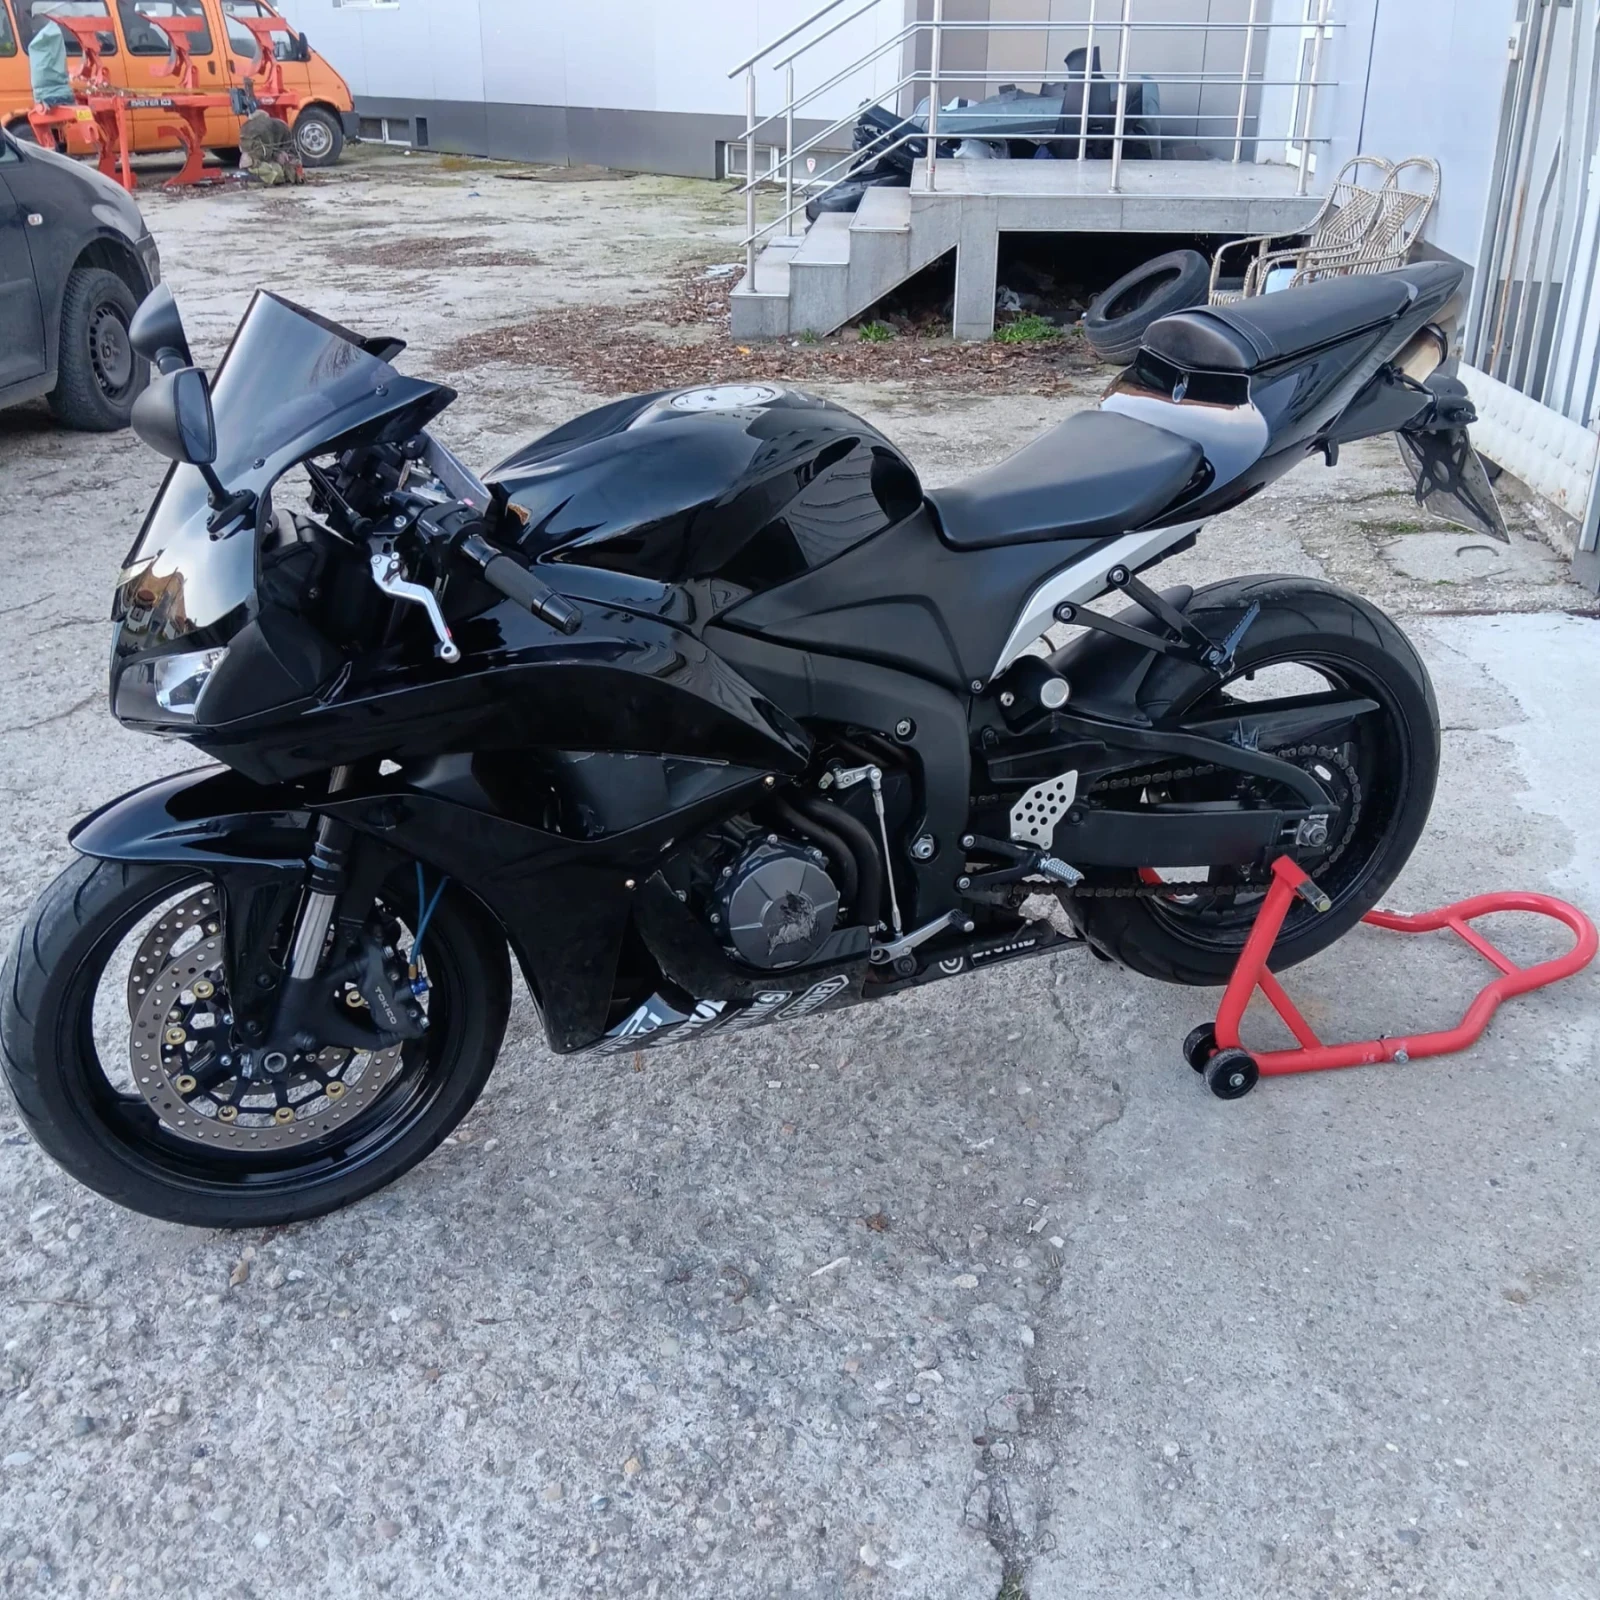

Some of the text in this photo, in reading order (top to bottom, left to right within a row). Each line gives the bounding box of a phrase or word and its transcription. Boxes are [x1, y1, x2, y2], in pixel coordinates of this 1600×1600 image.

[130, 98, 159, 107] MASTER
[375, 986, 397, 1025] TOKICO
[783, 982, 843, 1016] SHOEI
[649, 1000, 728, 1046] MOTUL
